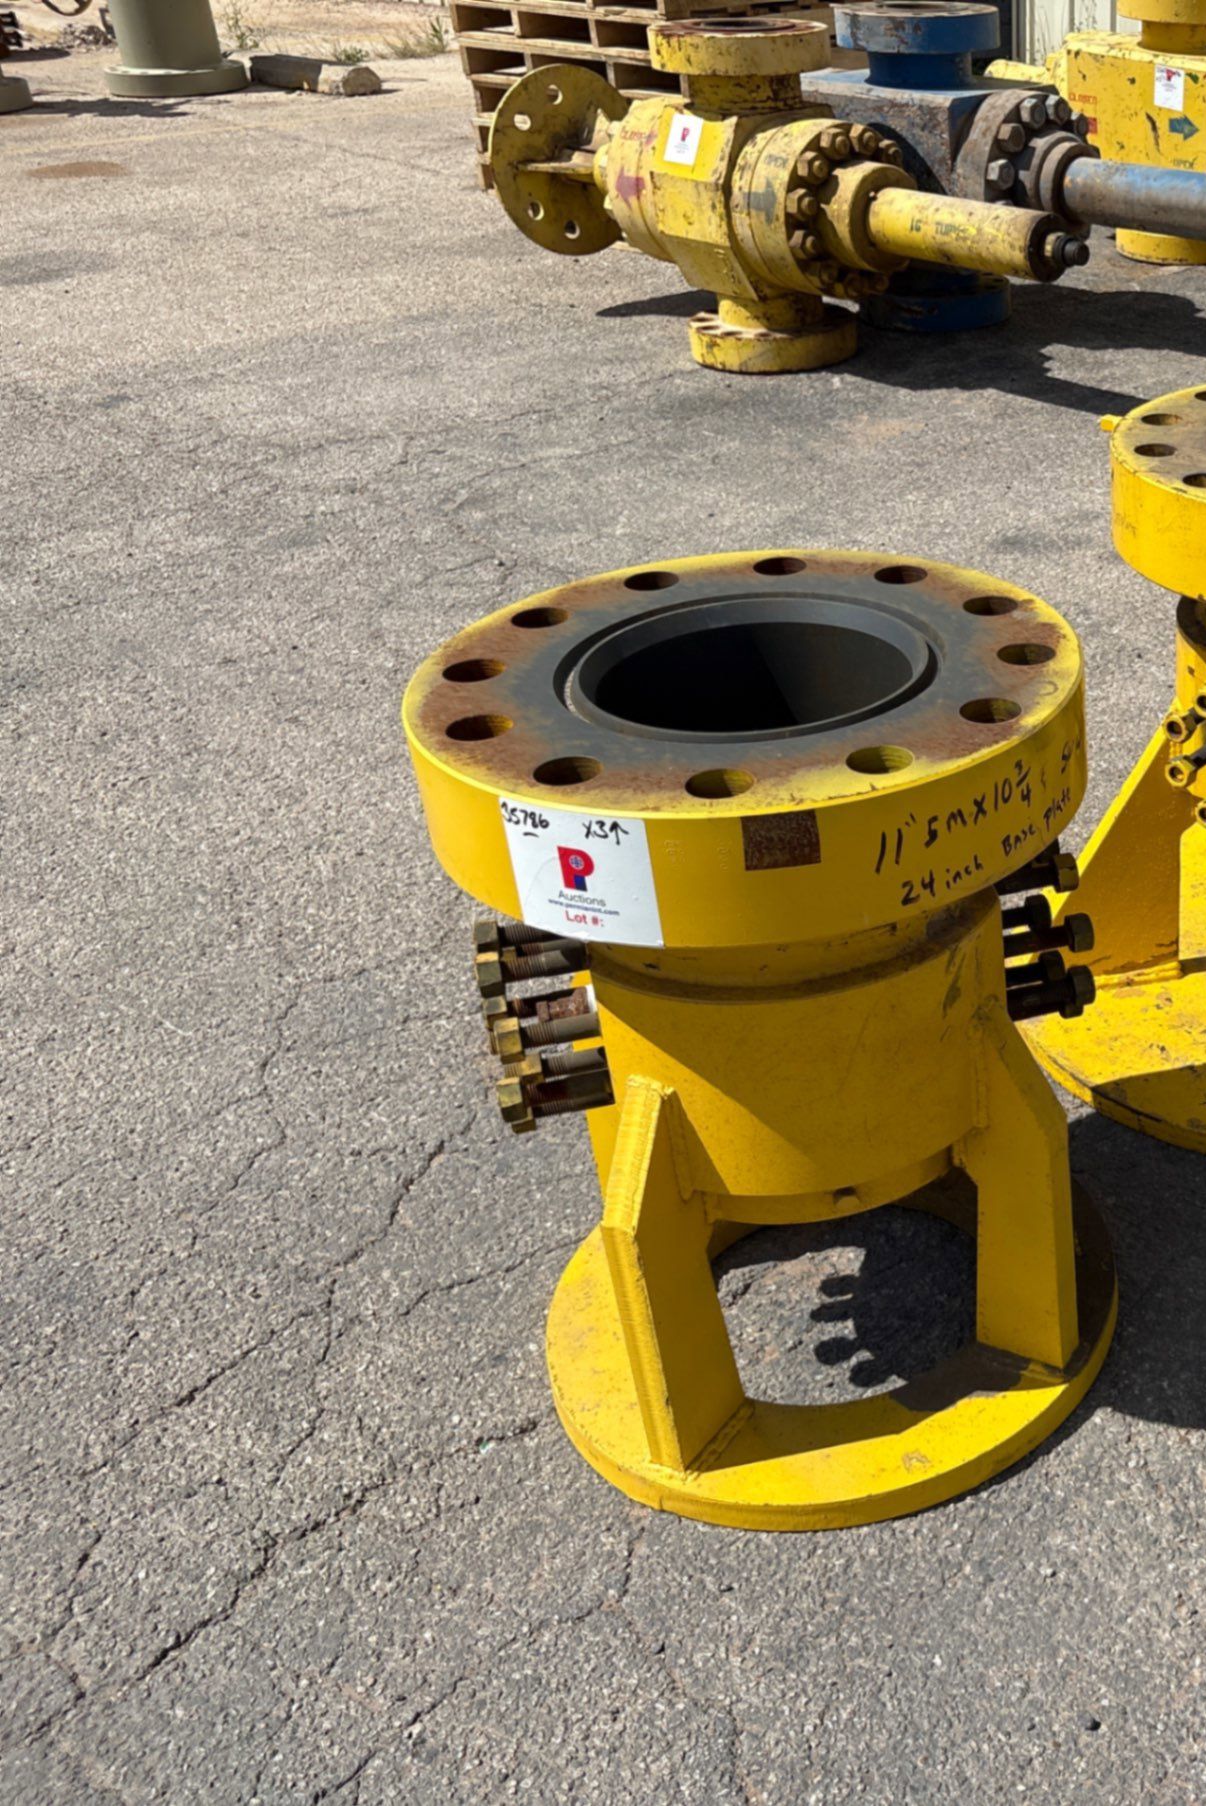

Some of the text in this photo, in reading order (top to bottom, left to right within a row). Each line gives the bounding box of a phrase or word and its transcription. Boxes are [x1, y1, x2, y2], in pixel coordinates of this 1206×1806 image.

[901, 869, 937, 906] 24
[945, 853, 984, 890] inch
[558, 889, 607, 908] Auctions
[565, 910, 588, 925] Lot
